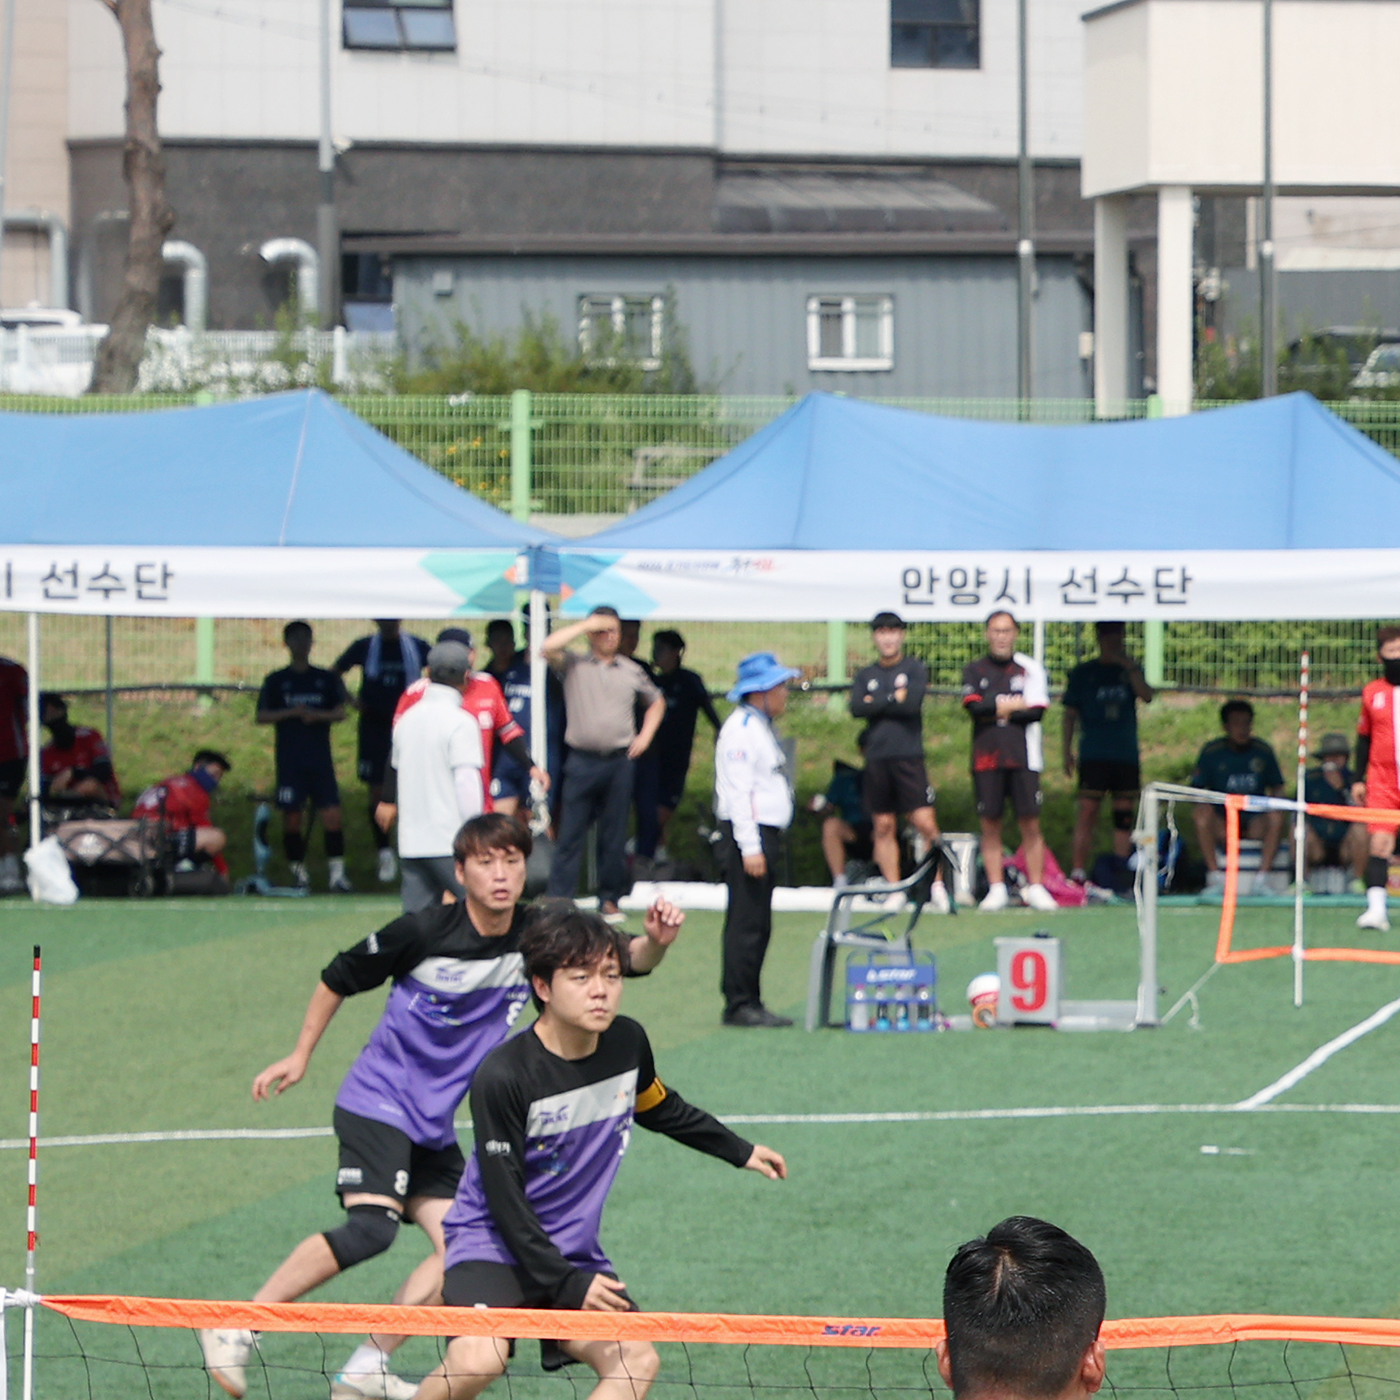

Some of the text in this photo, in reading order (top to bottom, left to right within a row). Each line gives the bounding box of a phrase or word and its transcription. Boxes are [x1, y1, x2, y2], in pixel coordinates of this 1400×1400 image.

[41, 560, 174, 600] 선수단
[902, 565, 1193, 606] 안양시 선수단
[1010, 949, 1049, 1013] 9
